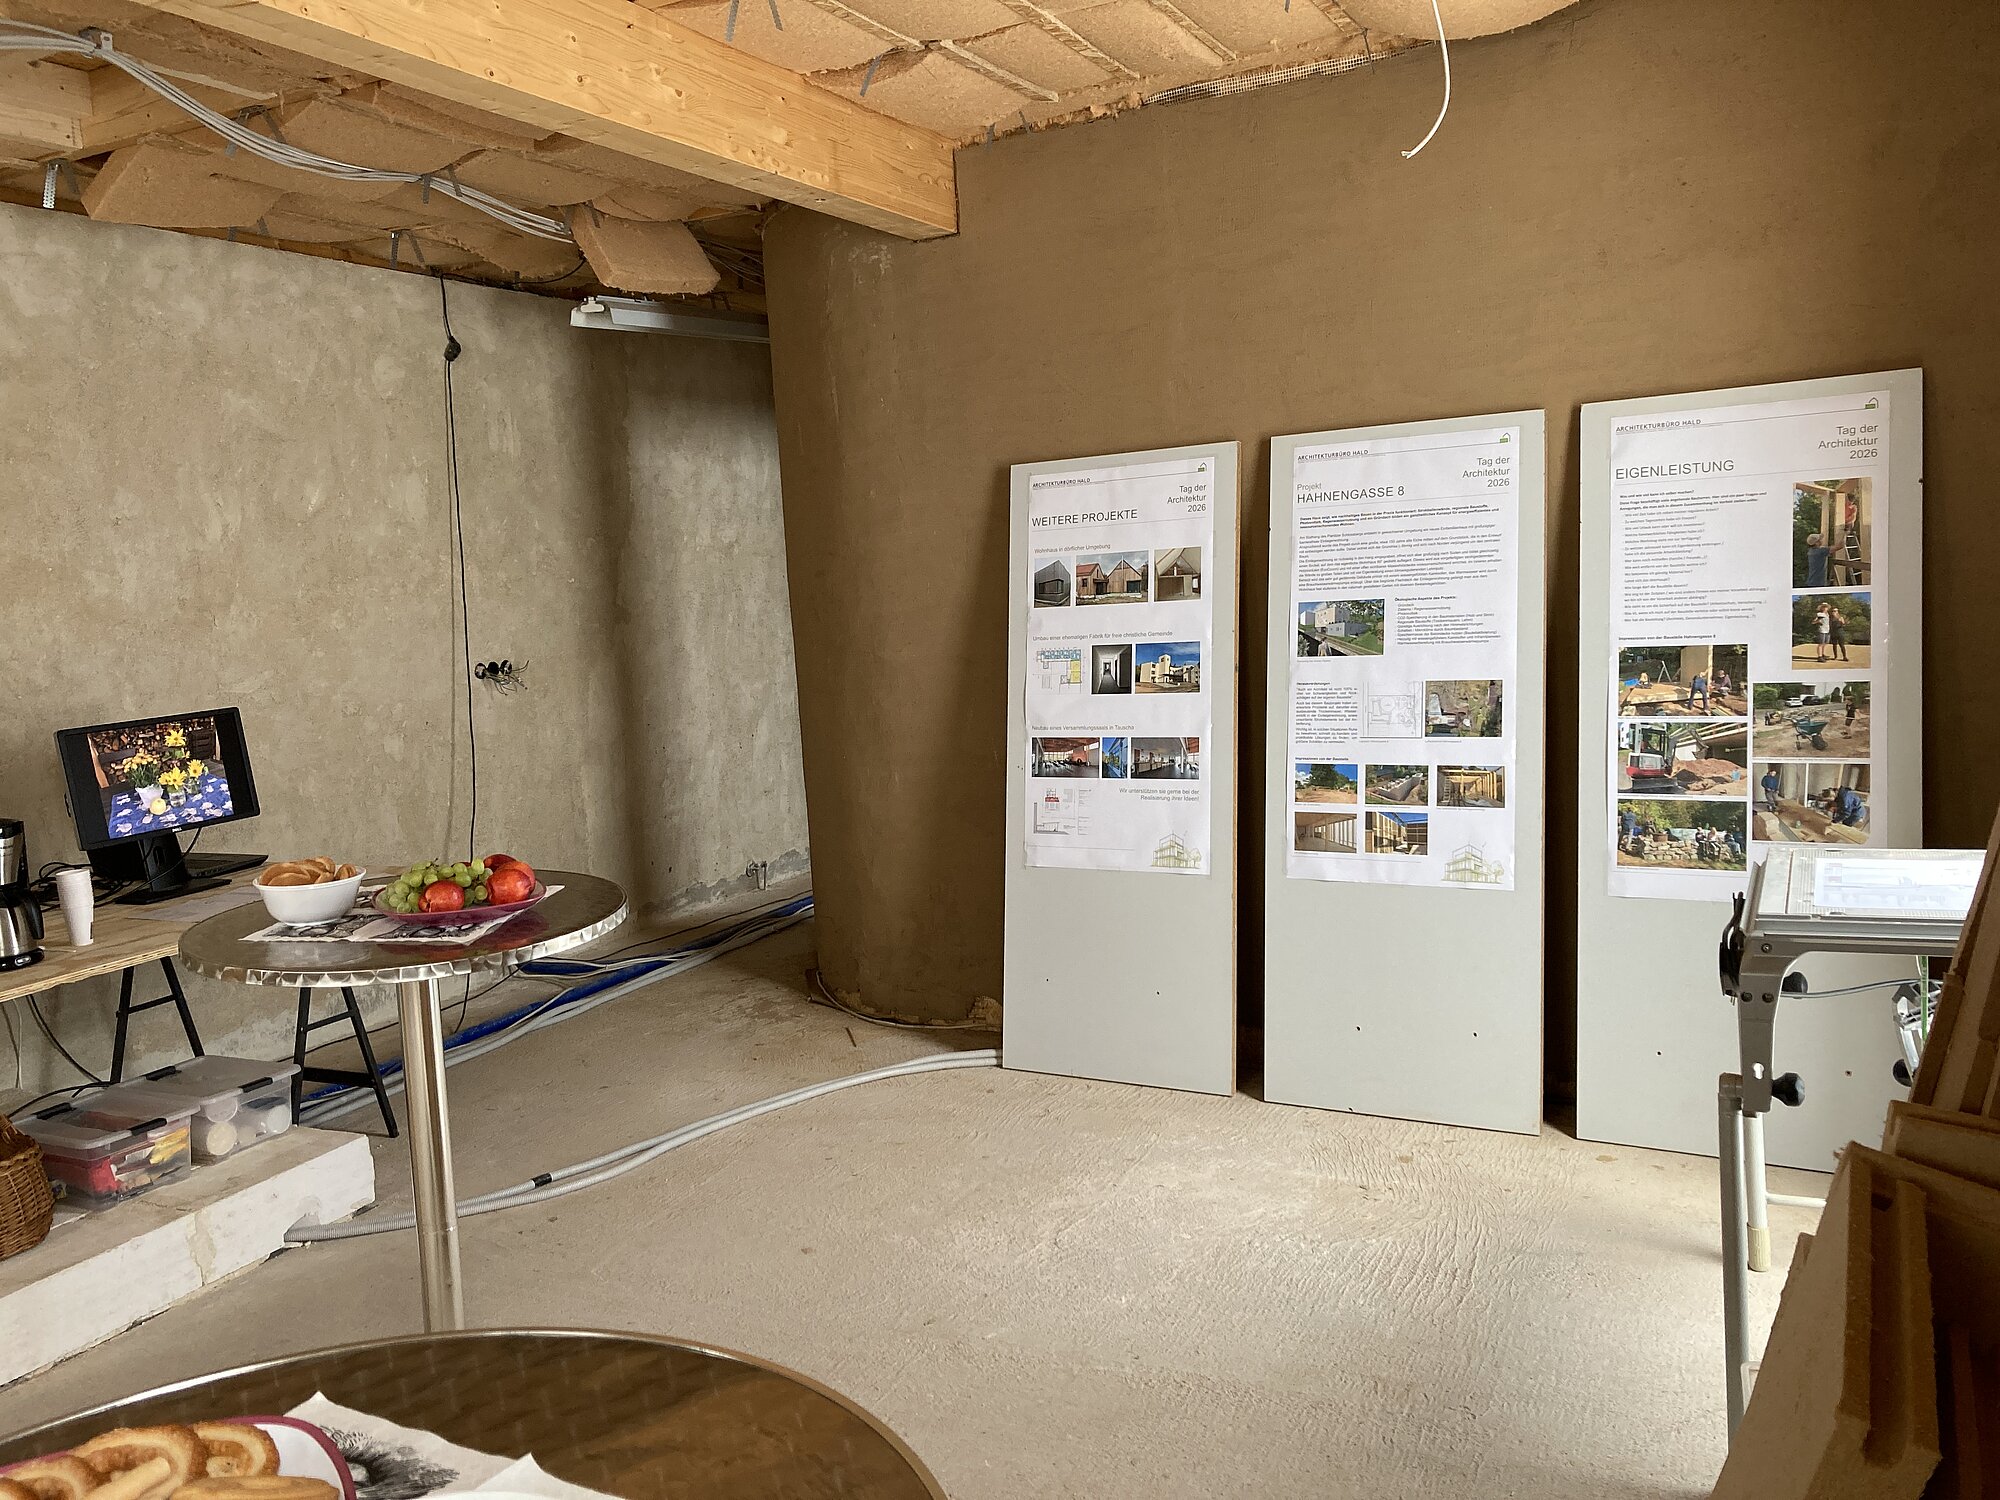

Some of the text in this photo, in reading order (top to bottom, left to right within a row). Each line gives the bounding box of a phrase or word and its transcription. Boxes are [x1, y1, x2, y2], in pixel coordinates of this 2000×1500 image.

[1616, 421, 1680, 432] ARCHITEKTURBÜRO
[1836, 424, 1878, 436] Tag der
[1818, 437, 1878, 449] Architektur
[1850, 448, 1878, 459] 2026
[1477, 456, 1510, 467] Tag der
[1462, 468, 1510, 478] Architektur
[1616, 460, 1734, 479] EIGENLEISTUNG
[1297, 483, 1322, 492] Projekt
[1487, 478, 1510, 487] 2026
[1179, 484, 1206, 494] Tag der
[1297, 486, 1405, 503] HAHNENGASSE 8
[1167, 495, 1206, 504] Architektur
[1187, 504, 1206, 513] 2026
[1032, 509, 1138, 527] WEITERE PROJEKTE
